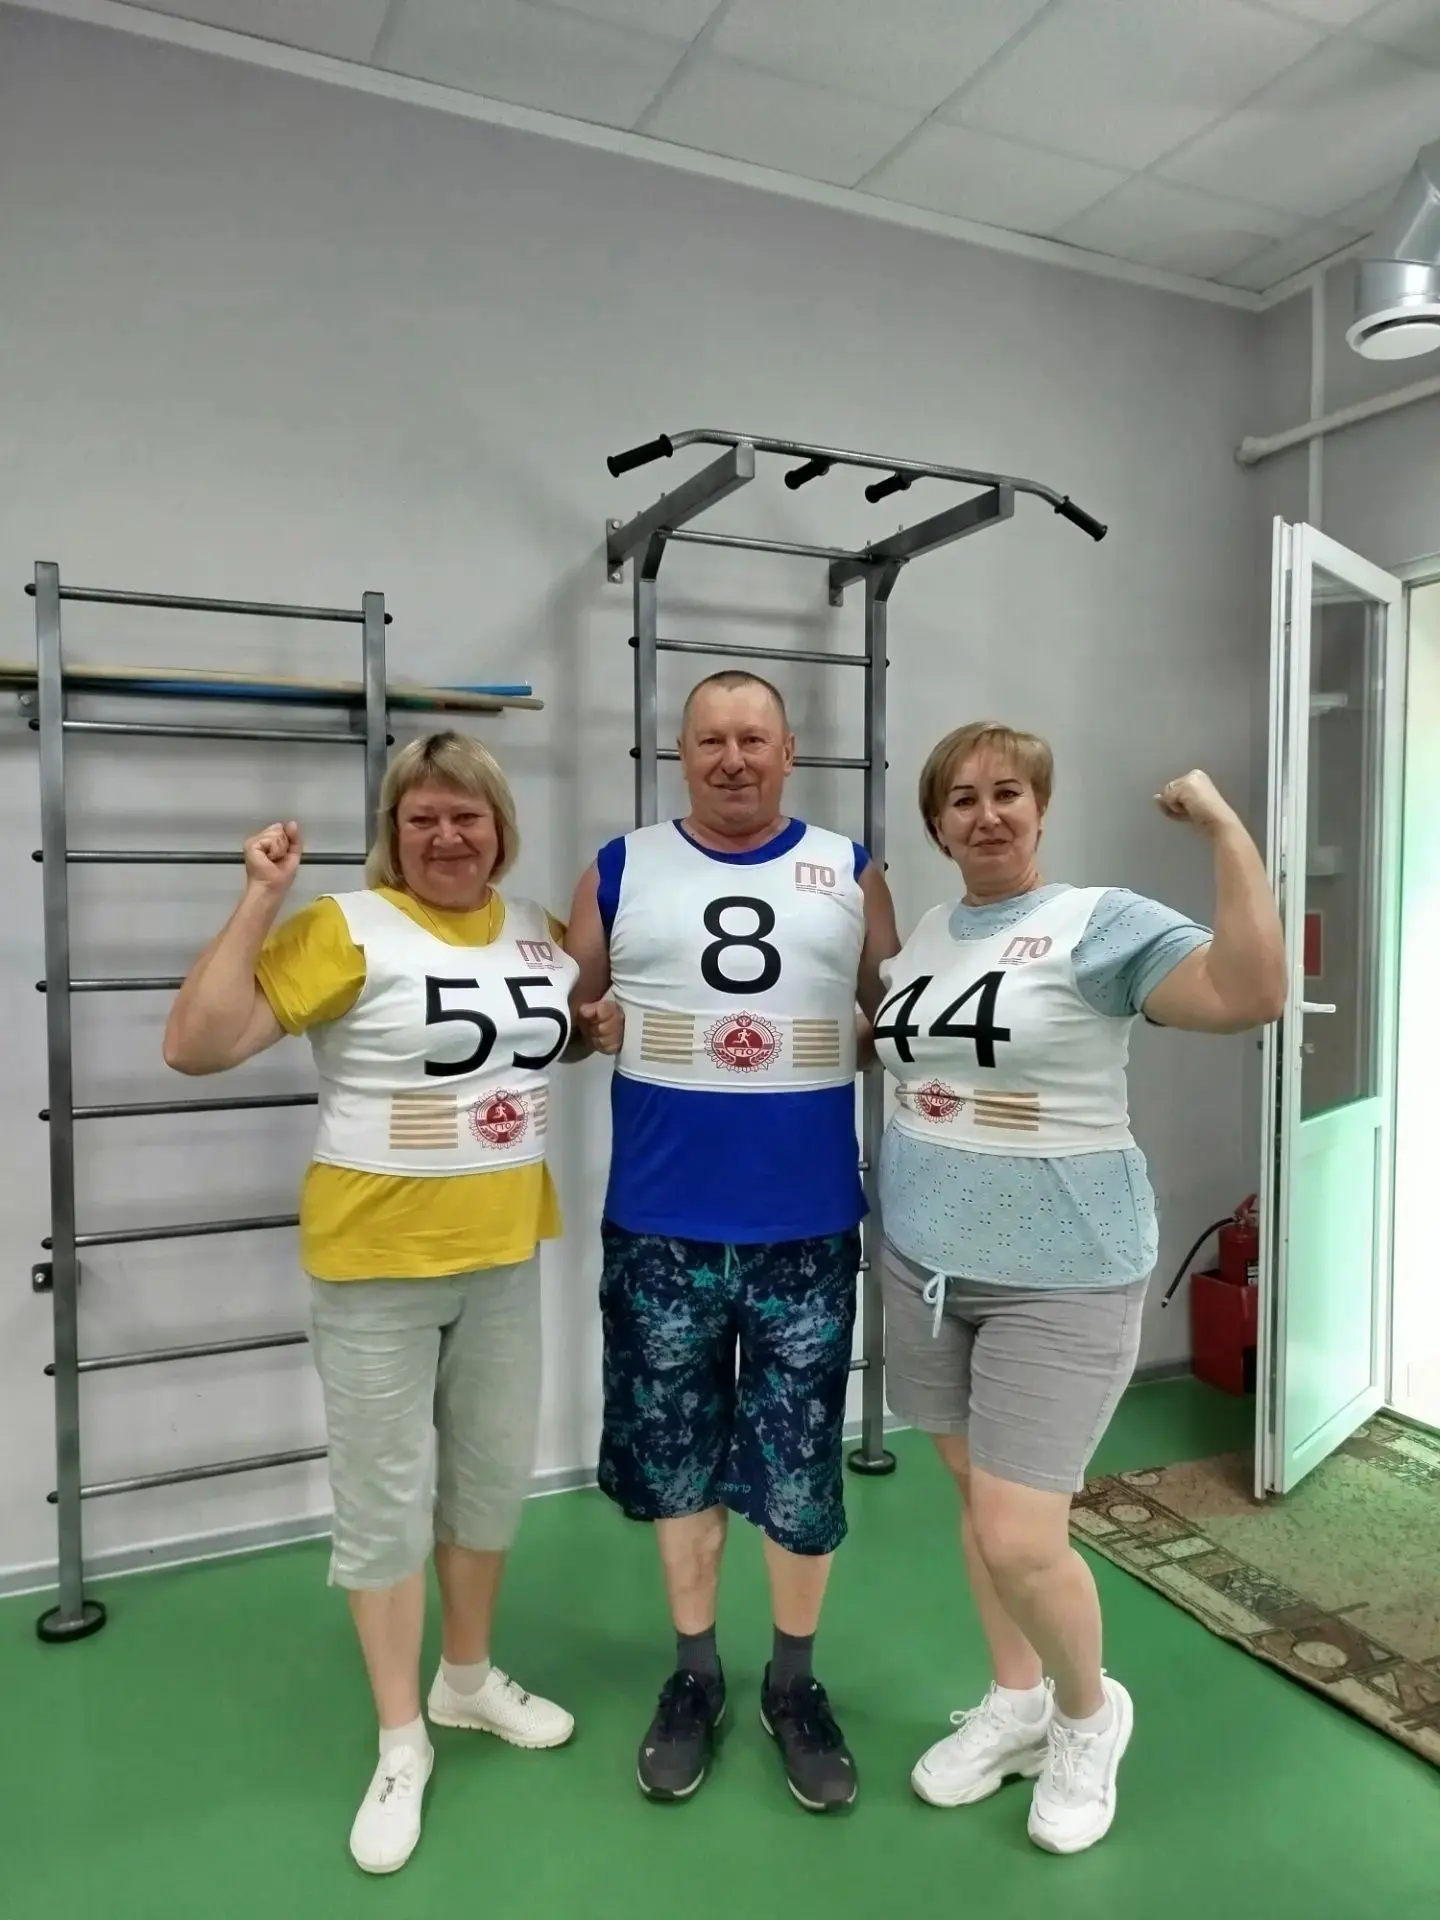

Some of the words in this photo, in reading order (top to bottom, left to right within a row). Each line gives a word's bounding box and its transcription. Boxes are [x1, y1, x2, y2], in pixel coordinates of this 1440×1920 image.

[700, 896, 782, 995] 8
[1002, 936, 1053, 958] ГТО
[424, 975, 568, 1077] 55
[873, 970, 1011, 1068] 44
